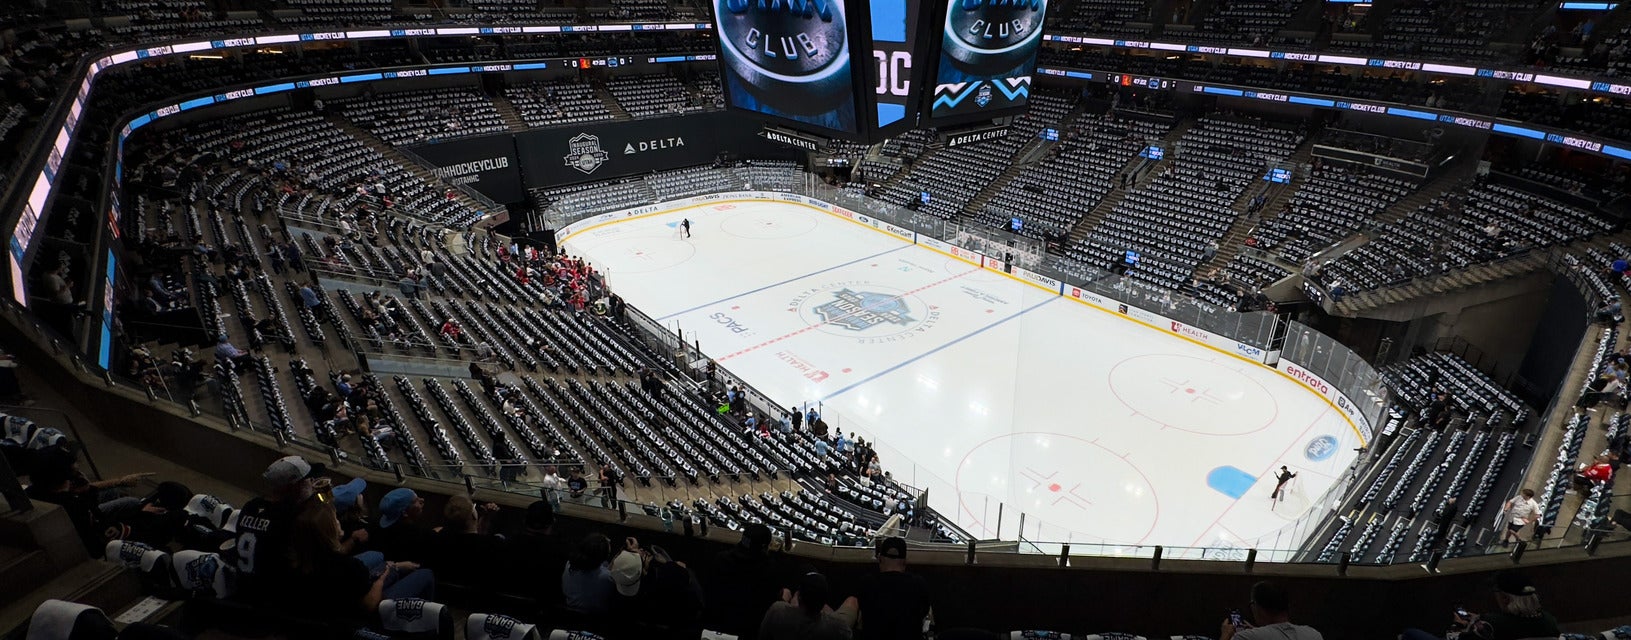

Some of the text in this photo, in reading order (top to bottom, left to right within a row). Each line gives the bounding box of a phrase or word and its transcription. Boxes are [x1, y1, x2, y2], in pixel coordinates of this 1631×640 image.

[392, 29, 405, 37] UTAH
[969, 18, 1024, 39] CLUB
[313, 32, 332, 40] HOCKEY
[746, 27, 818, 60] CLUB
[1369, 58, 1421, 70] UTAH HOCKEY CLUB
[1477, 69, 1533, 81] UTAH HOCKEY CLUB
[309, 78, 327, 87] HOCKEY
[1592, 81, 1631, 95] UTAH HOCKEY
[1336, 101, 1350, 109] UTAH
[1350, 103, 1371, 112] HOCKEY
[1439, 115, 1491, 129] UTAH HOCKEY CLUB
[772, 132, 817, 151] DELTA CENTER
[957, 130, 1008, 144] DELTA CENTER
[1547, 133, 1601, 152] UTAH HOCKEY CLUB
[572, 146, 600, 156] SEASON
[639, 137, 685, 152] DELTA
[634, 206, 658, 215] DELTA
[832, 206, 853, 218] SEATGEEK
[789, 288, 818, 307] DELTA
[1082, 293, 1102, 305] TOYOTA
[832, 299, 886, 326] SEASON
[710, 312, 748, 334] PACS
[916, 311, 940, 332] DELTA
[1182, 326, 1208, 341] HEALTH
[775, 351, 810, 373] HEALTH
[1286, 365, 1328, 395] entrata
[239, 515, 272, 532] KELLER
[121, 543, 145, 557] GAME
[236, 531, 257, 574] 9
[396, 599, 424, 610] GAME
[487, 614, 515, 628] GAME
